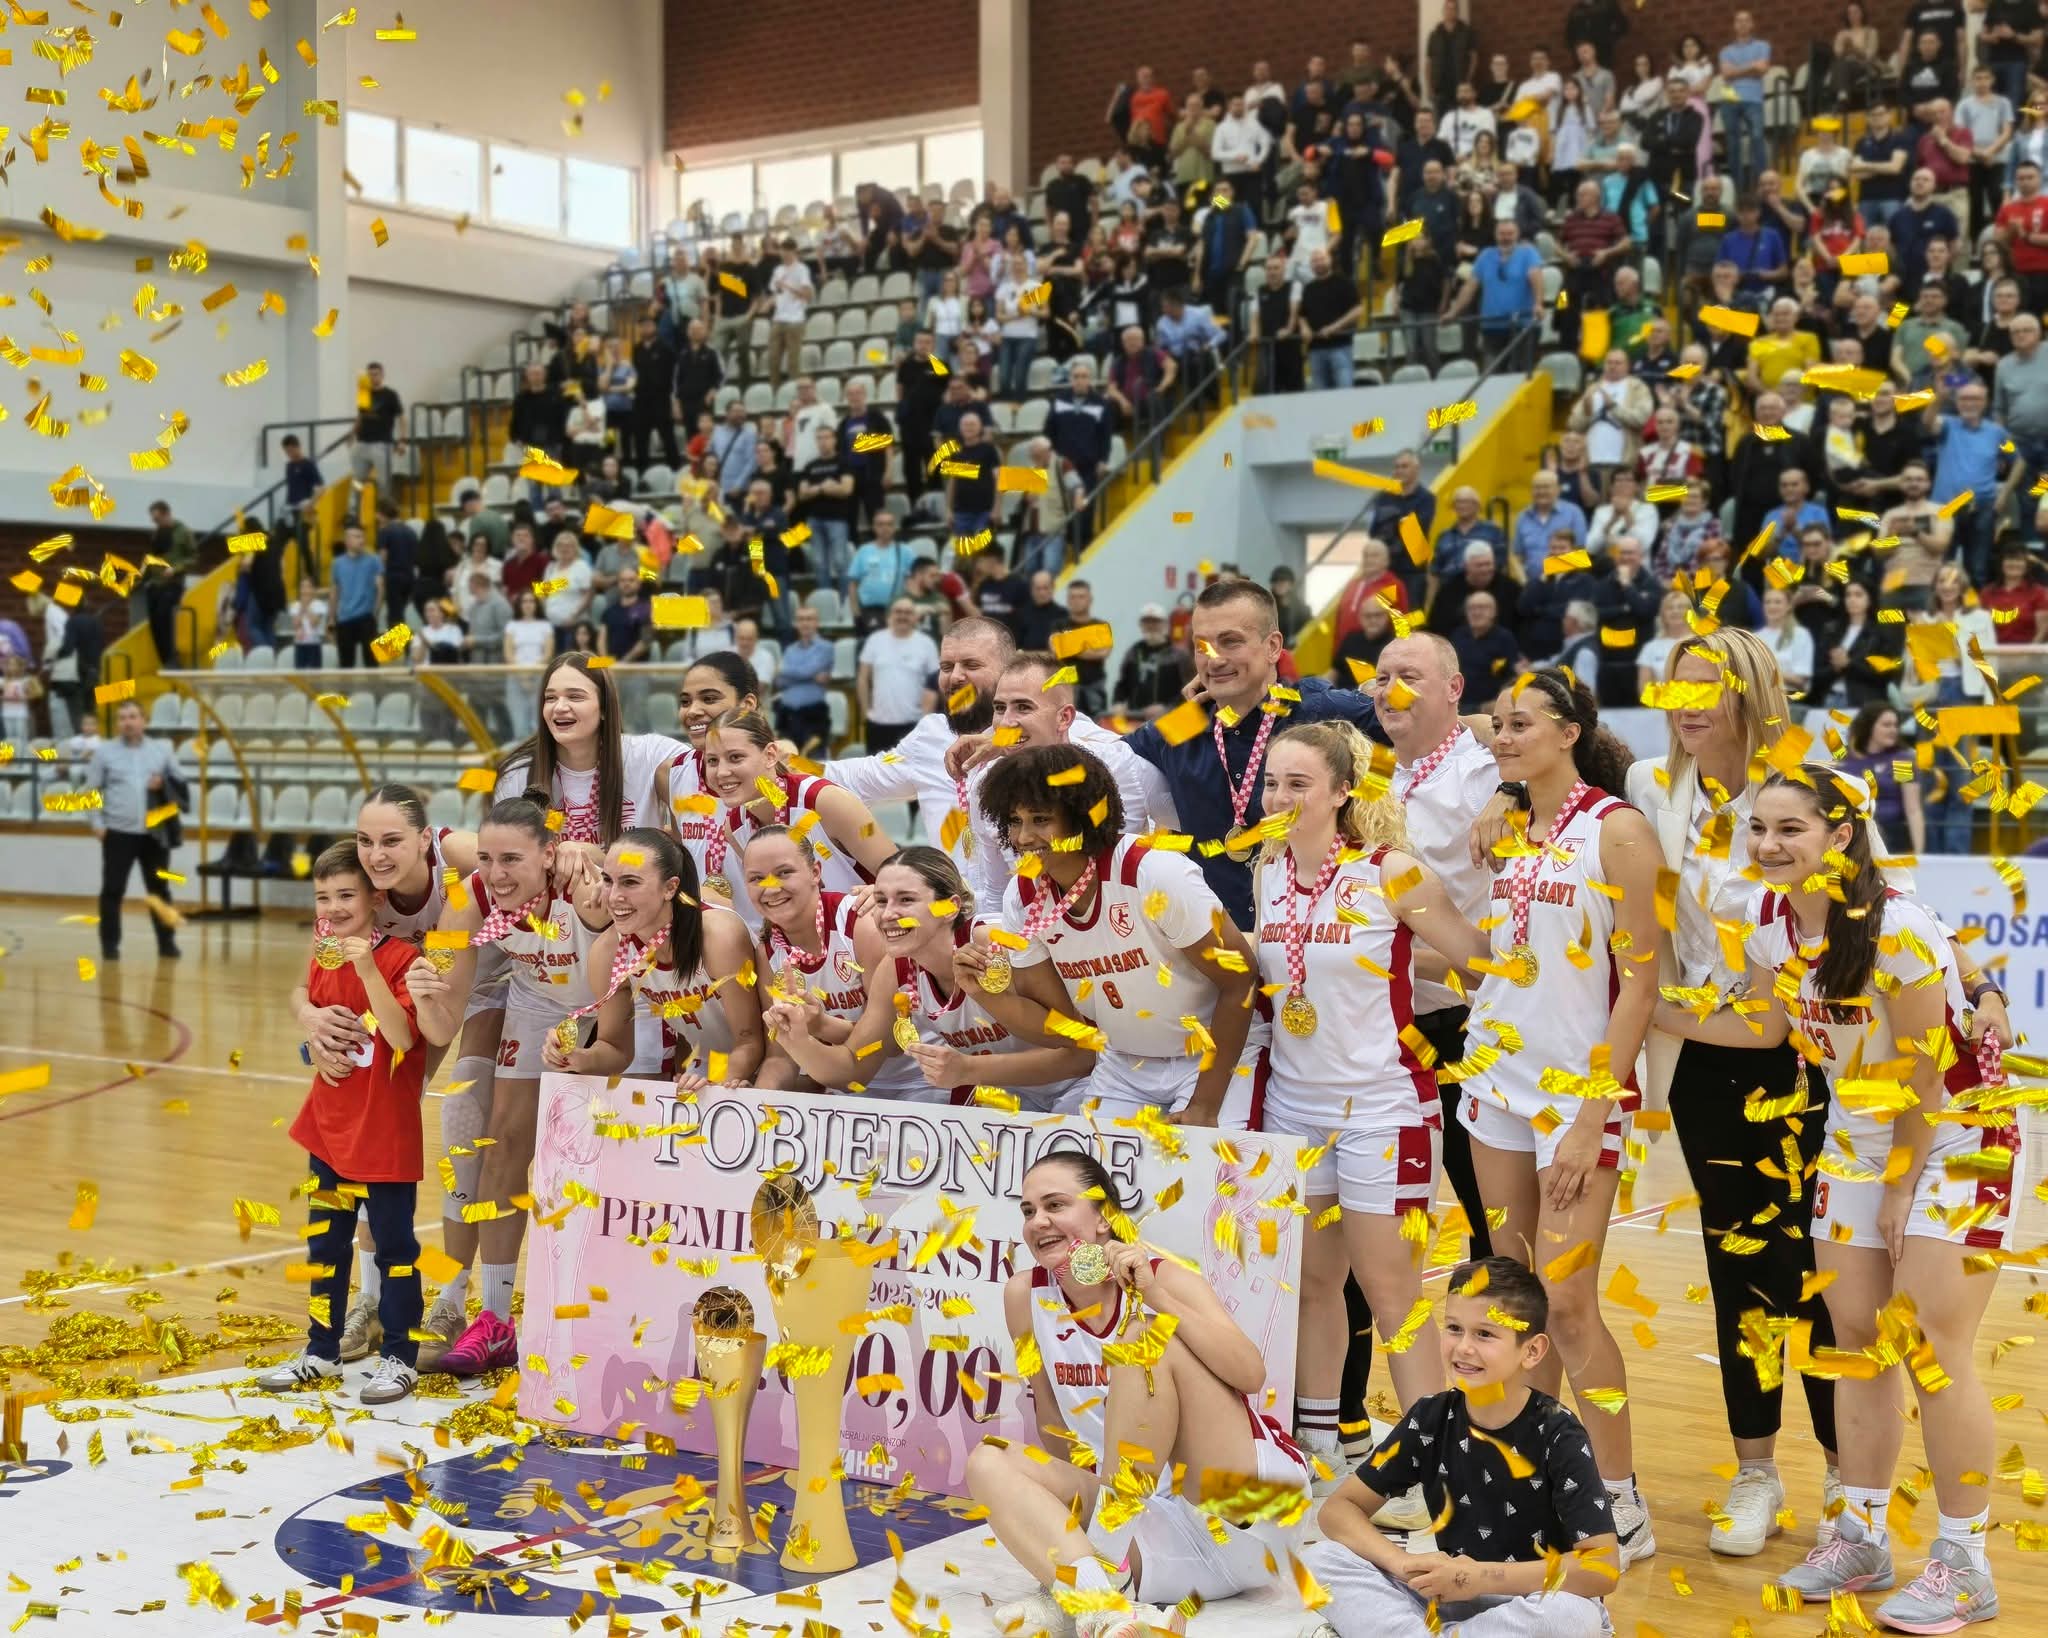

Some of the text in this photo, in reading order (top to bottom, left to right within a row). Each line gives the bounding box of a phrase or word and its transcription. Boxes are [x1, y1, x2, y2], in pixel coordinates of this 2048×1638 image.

[1537, 880, 1576, 907] SAVI
[1261, 923, 1287, 943] BRO
[1315, 923, 1352, 944] SAVI
[1112, 947, 1149, 972] SAVI
[1102, 980, 1123, 1009] 8
[1055, 1362, 1092, 1387] BROD
